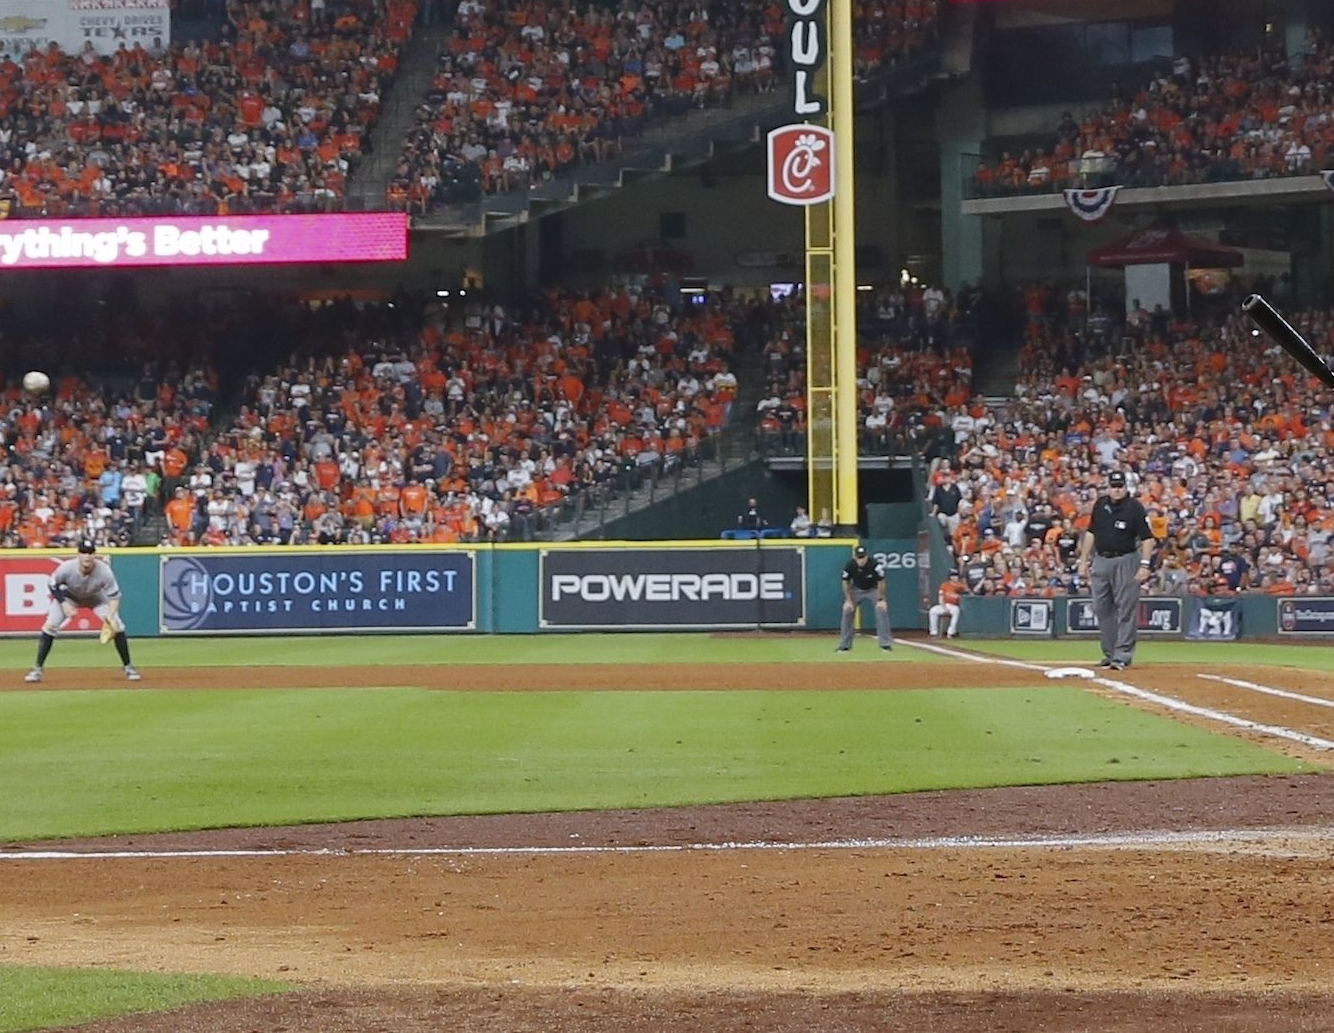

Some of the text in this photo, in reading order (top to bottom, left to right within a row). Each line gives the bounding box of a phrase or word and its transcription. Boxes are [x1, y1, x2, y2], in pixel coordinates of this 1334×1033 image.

[154, 225, 269, 255] Better
[873, 552, 916, 569] 326
[191, 569, 456, 595] HOUSTON'S FIRST
[552, 572, 786, 603] POWERADE
[191, 597, 407, 614] BAPTIST CHURCH
